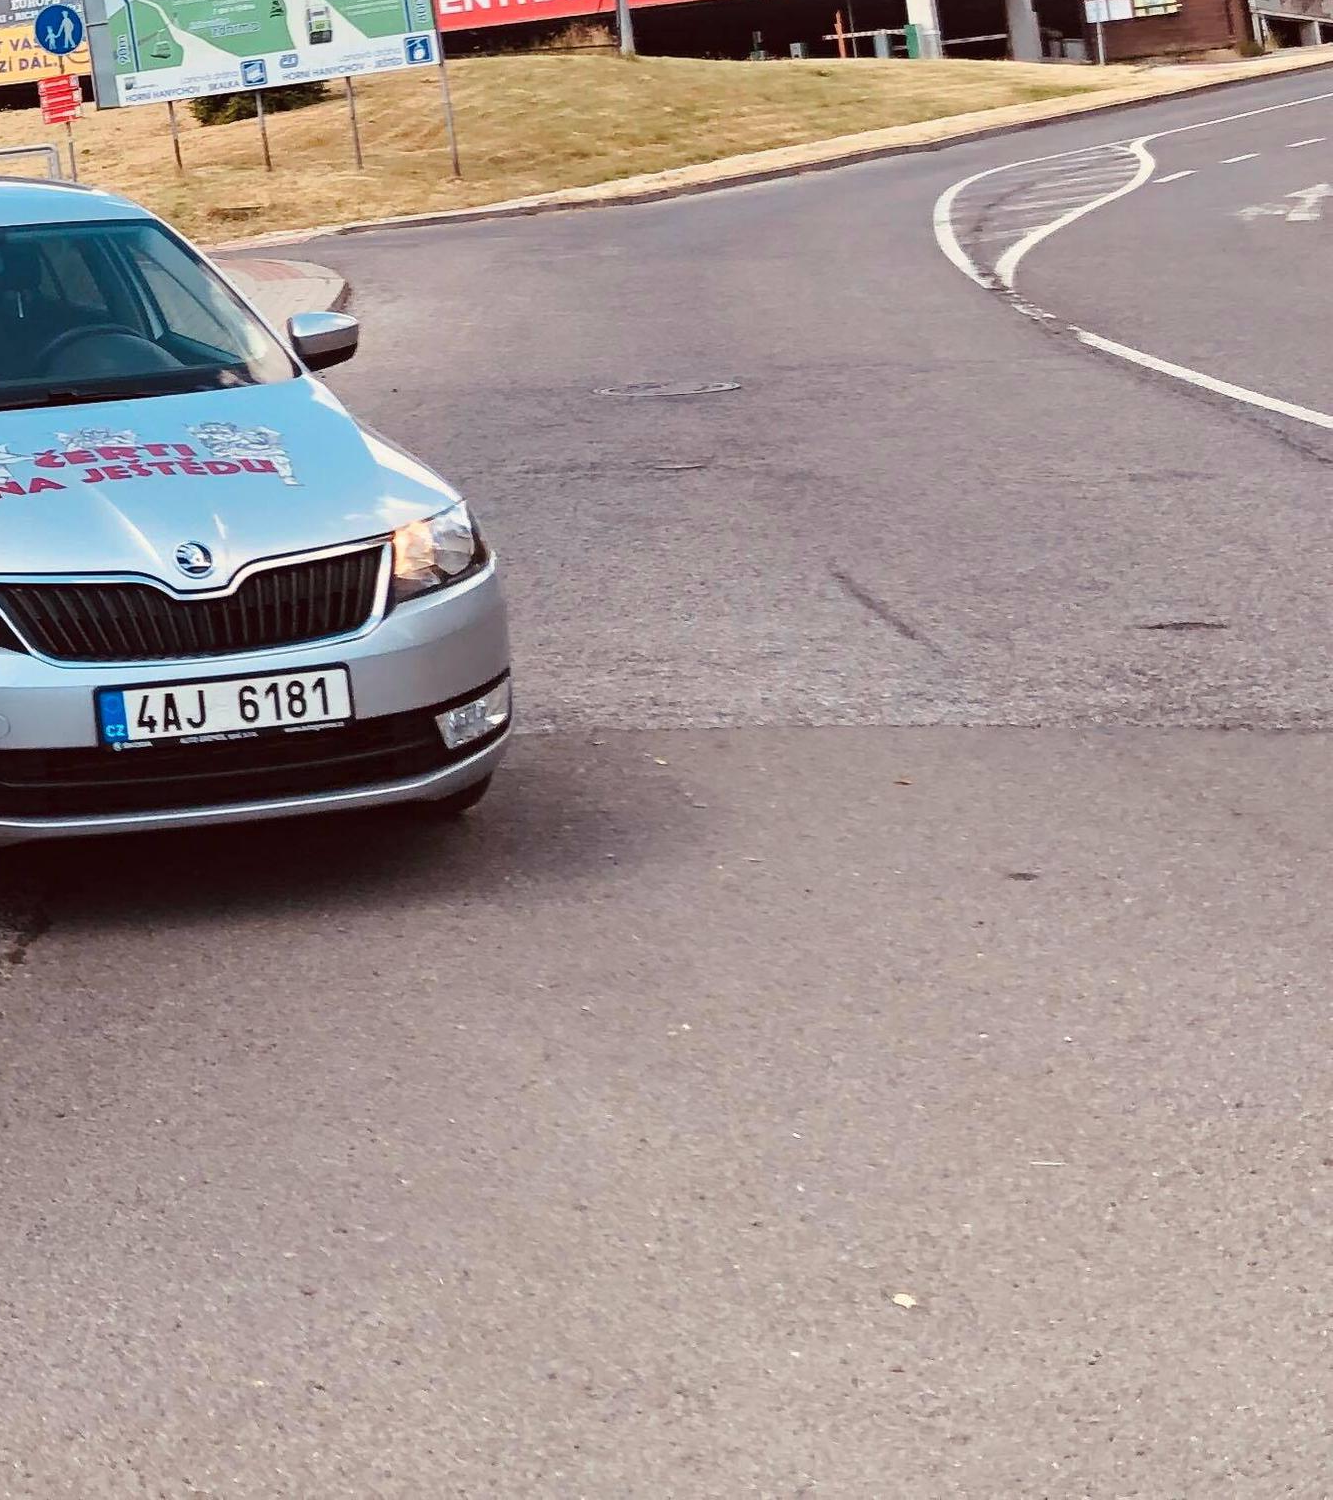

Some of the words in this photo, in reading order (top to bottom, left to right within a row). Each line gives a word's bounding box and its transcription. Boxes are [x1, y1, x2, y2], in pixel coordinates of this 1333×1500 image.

[33, 443, 199, 469] ČERTI
[81, 454, 279, 484] JEŠTĚDU
[137, 689, 207, 733] 4AJ
[238, 676, 330, 723] 6181
[105, 724, 125, 738] CZ
